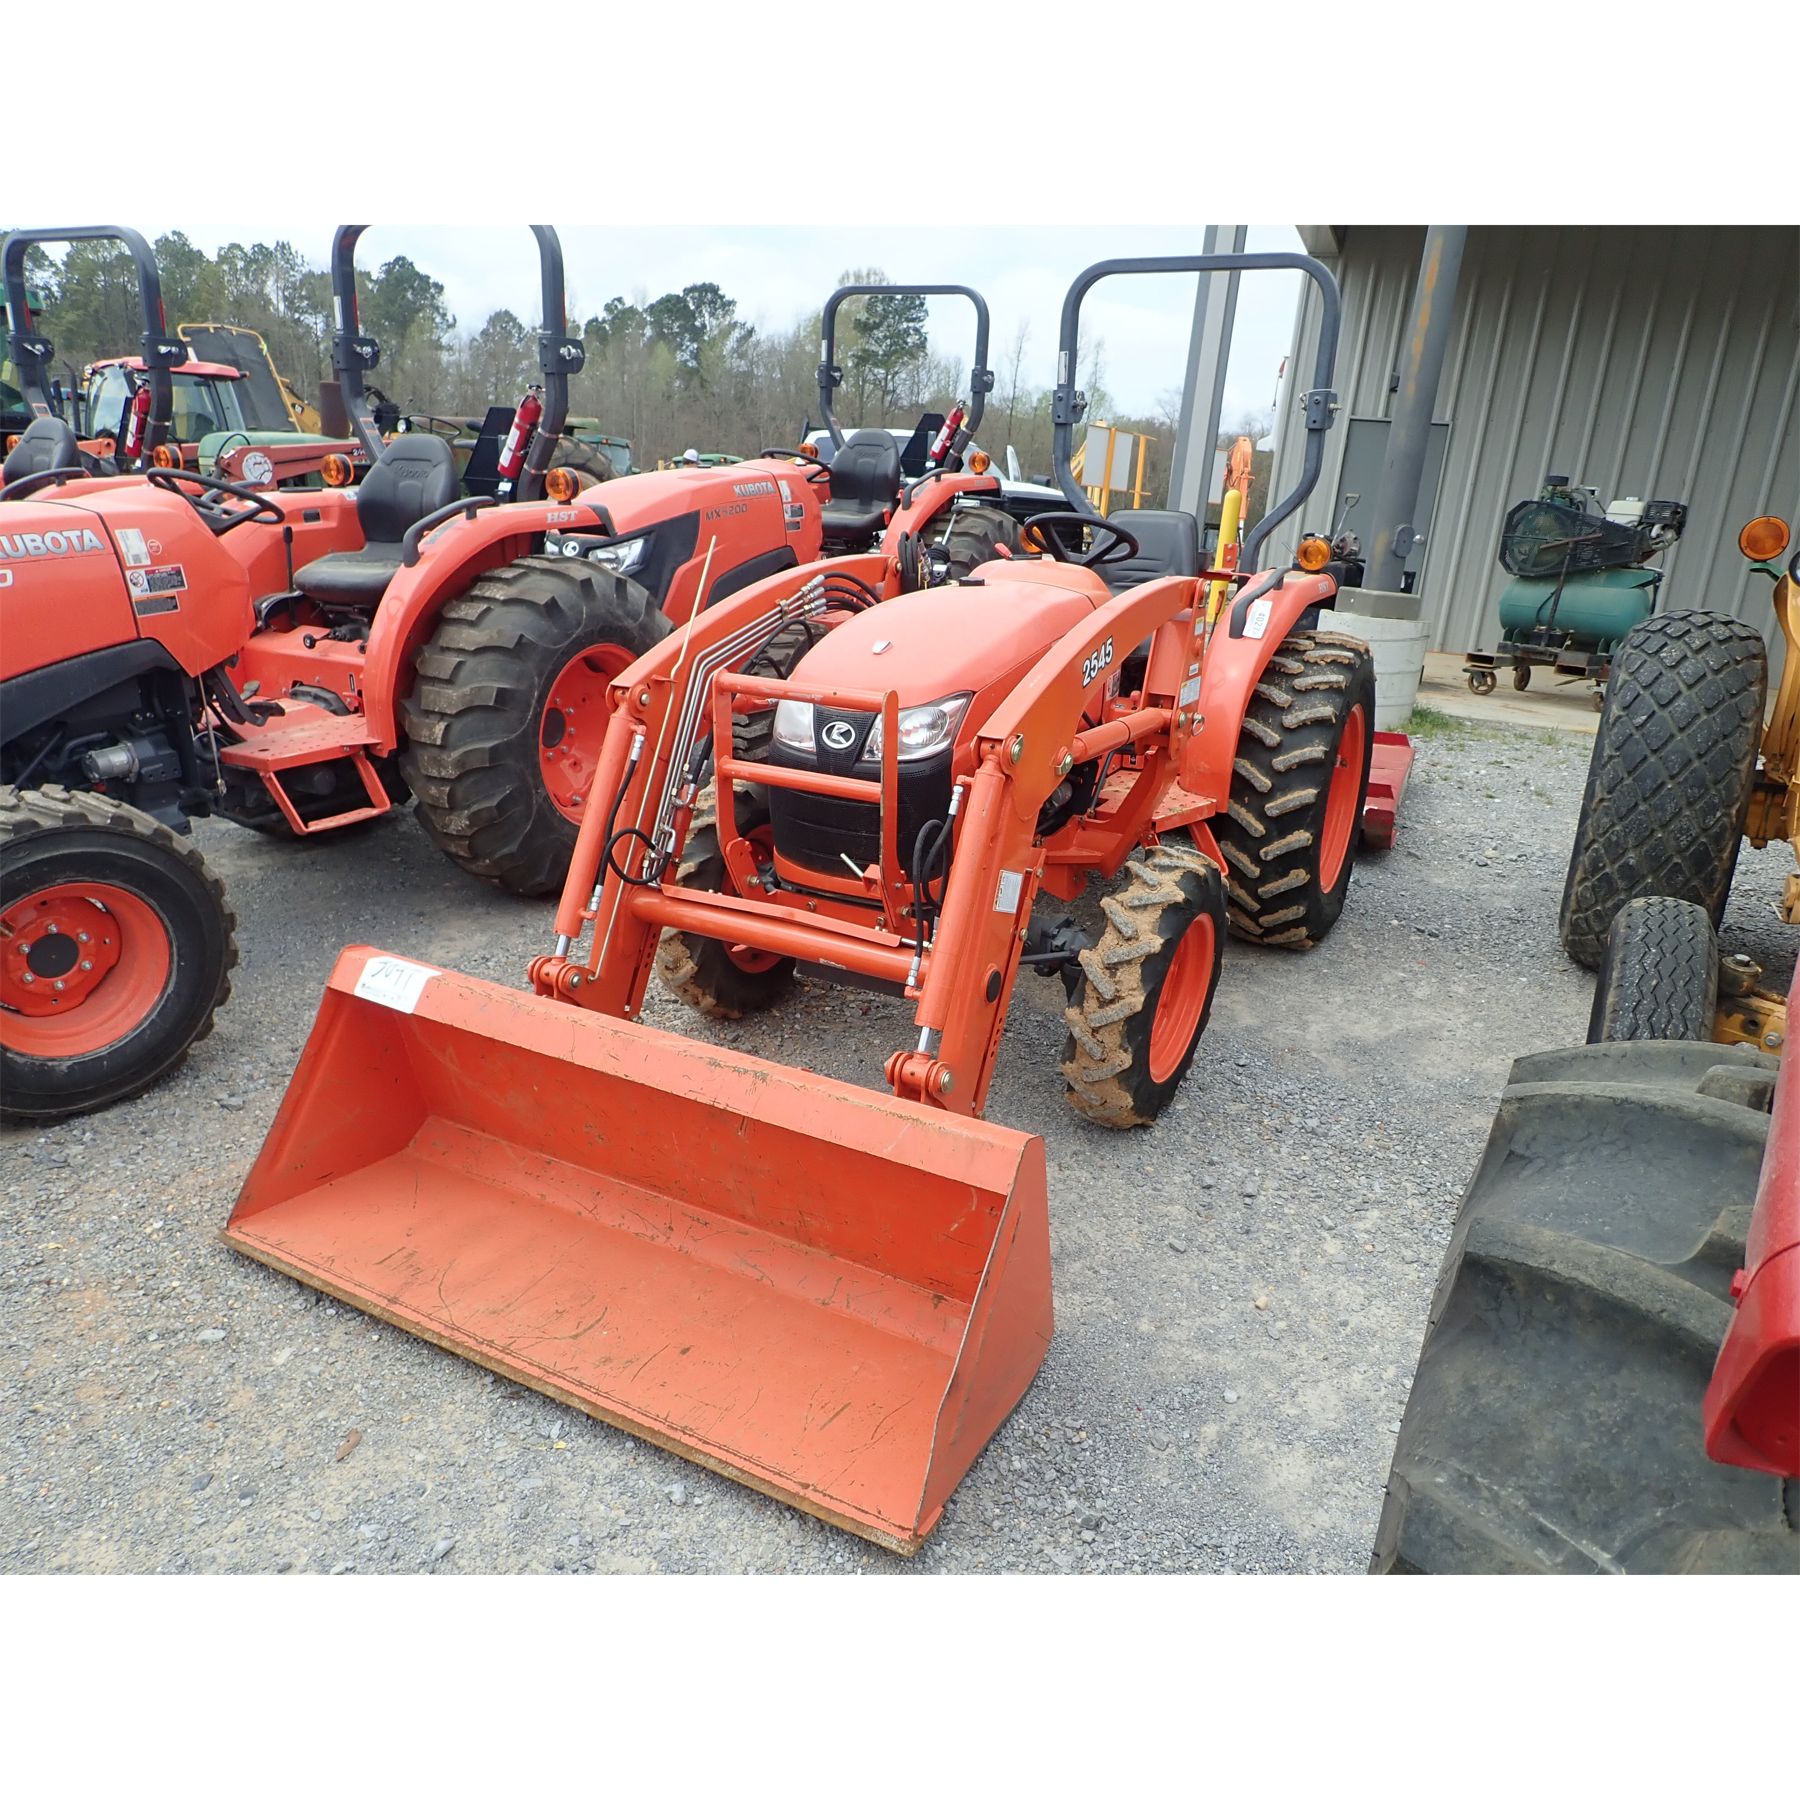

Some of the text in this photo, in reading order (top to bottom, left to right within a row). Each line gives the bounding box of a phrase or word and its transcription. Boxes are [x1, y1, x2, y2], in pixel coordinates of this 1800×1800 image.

[733, 481, 776, 498] KUBOTA
[546, 510, 578, 523] HST
[0, 528, 105, 560] UBOTA
[1082, 635, 1113, 688] 2545
